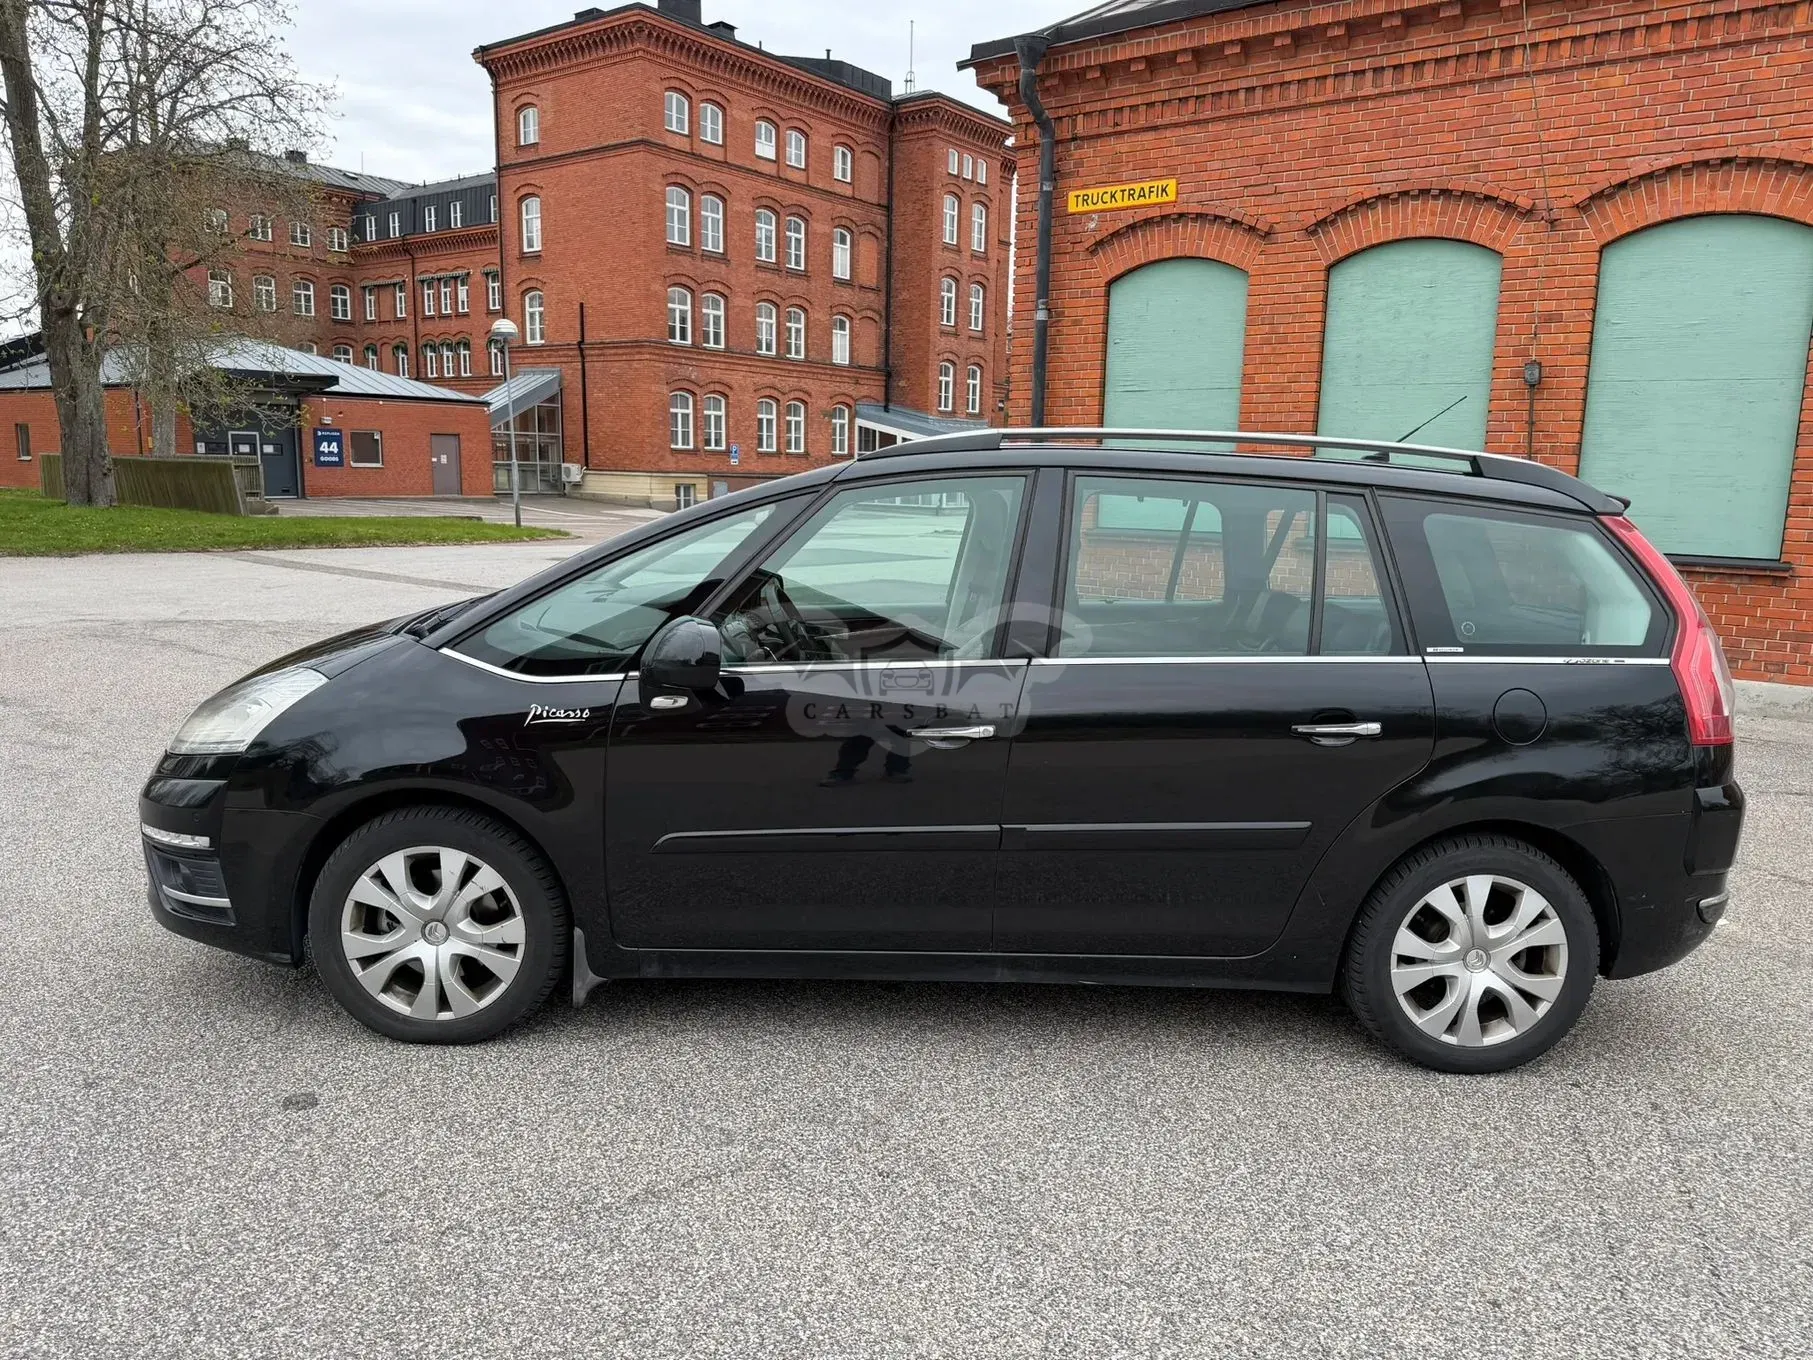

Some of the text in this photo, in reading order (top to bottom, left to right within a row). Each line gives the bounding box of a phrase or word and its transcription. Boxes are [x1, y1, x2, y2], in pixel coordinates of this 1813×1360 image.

[1074, 184, 1169, 208] TRUCKTRAFIK
[319, 441, 339, 454] 44
[523, 703, 590, 727] Picasso
